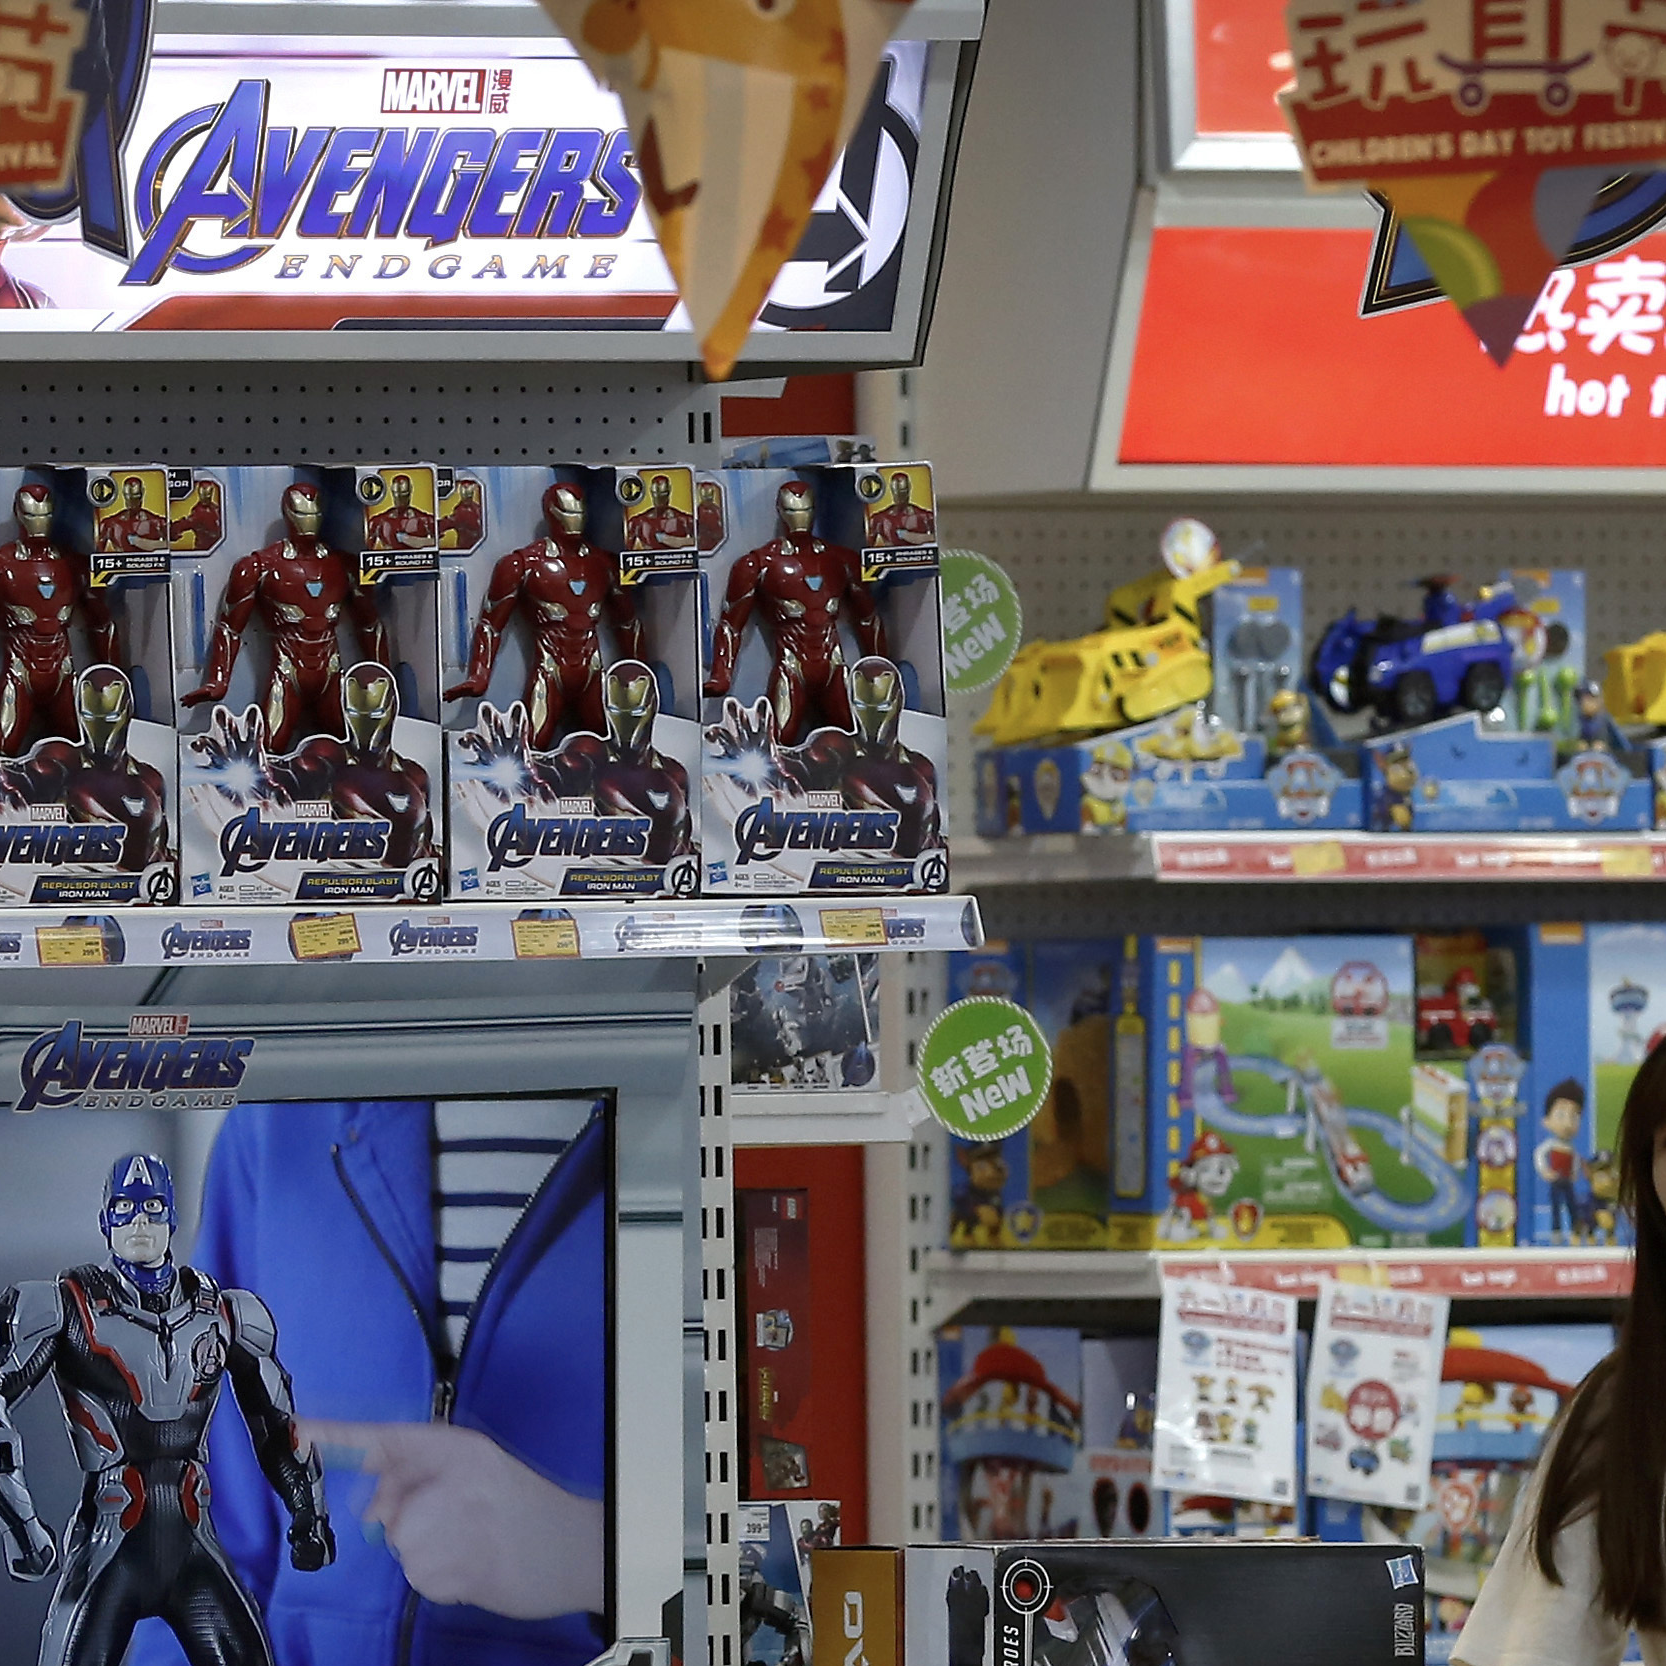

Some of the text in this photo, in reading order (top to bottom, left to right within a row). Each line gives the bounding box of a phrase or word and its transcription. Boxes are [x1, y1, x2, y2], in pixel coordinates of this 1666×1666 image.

[383, 70, 483, 114] MARVEL
[490, 69, 511, 114] 漫威
[1310, 134, 1451, 168] CHILDREN'S
[1458, 129, 1514, 158] DAY
[1522, 126, 1575, 155] TOY
[120, 78, 643, 286] AVENGERS
[275, 253, 618, 281] ENDGAME
[1545, 367, 1629, 417] hot
[96, 558, 122, 569] 15+
[32, 806, 65, 820] MARVEL
[734, 798, 897, 866] AVENGERS
[221, 805, 390, 877] AVENGERS
[487, 802, 648, 872] AVENGERS
[41, 881, 134, 890] REPULSOR BLAST
[59, 890, 109, 898] IRON MAN
[131, 1015, 176, 1036] MARVEL
[19, 1021, 254, 1110] AVENGERS
[929, 1025, 1032, 1095] 新登场
[87, 1093, 237, 1109] ENDGAME
[1395, 1603, 1414, 1656] BLIZZARD
